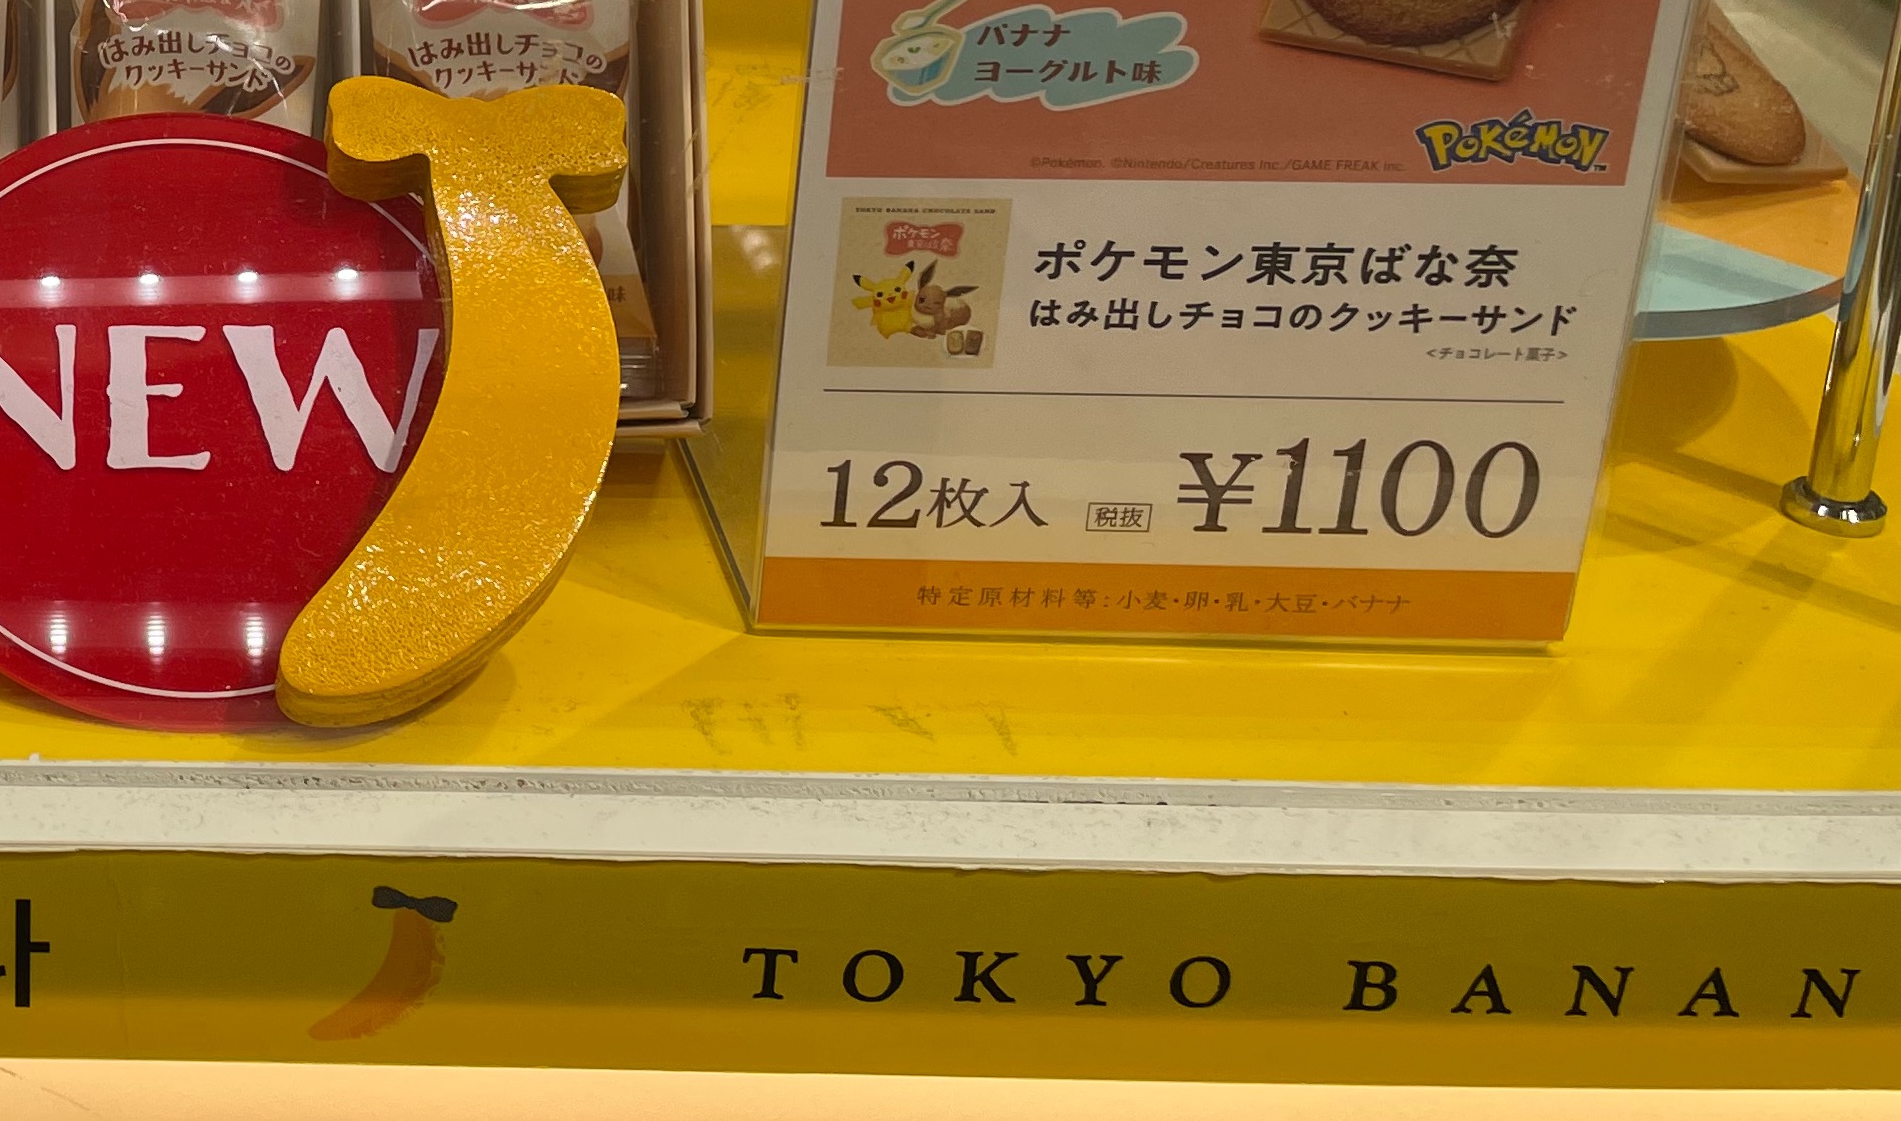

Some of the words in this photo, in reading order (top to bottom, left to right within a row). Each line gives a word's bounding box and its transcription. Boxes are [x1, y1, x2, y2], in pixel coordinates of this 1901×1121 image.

[976, 23, 1071, 47] バナナ
[974, 59, 1162, 84] ヨーグルト味
[1034, 240, 1519, 289] ポケモン東京ばな奈
[1029, 297, 1577, 338] はみ出しチョコのクッキーサンド
[1094, 506, 1144, 529] 税抜
[1177, 437, 1541, 539] ¥1100
[743, 947, 1232, 1009] TOKYO
[1343, 959, 1861, 1019] BANAN
